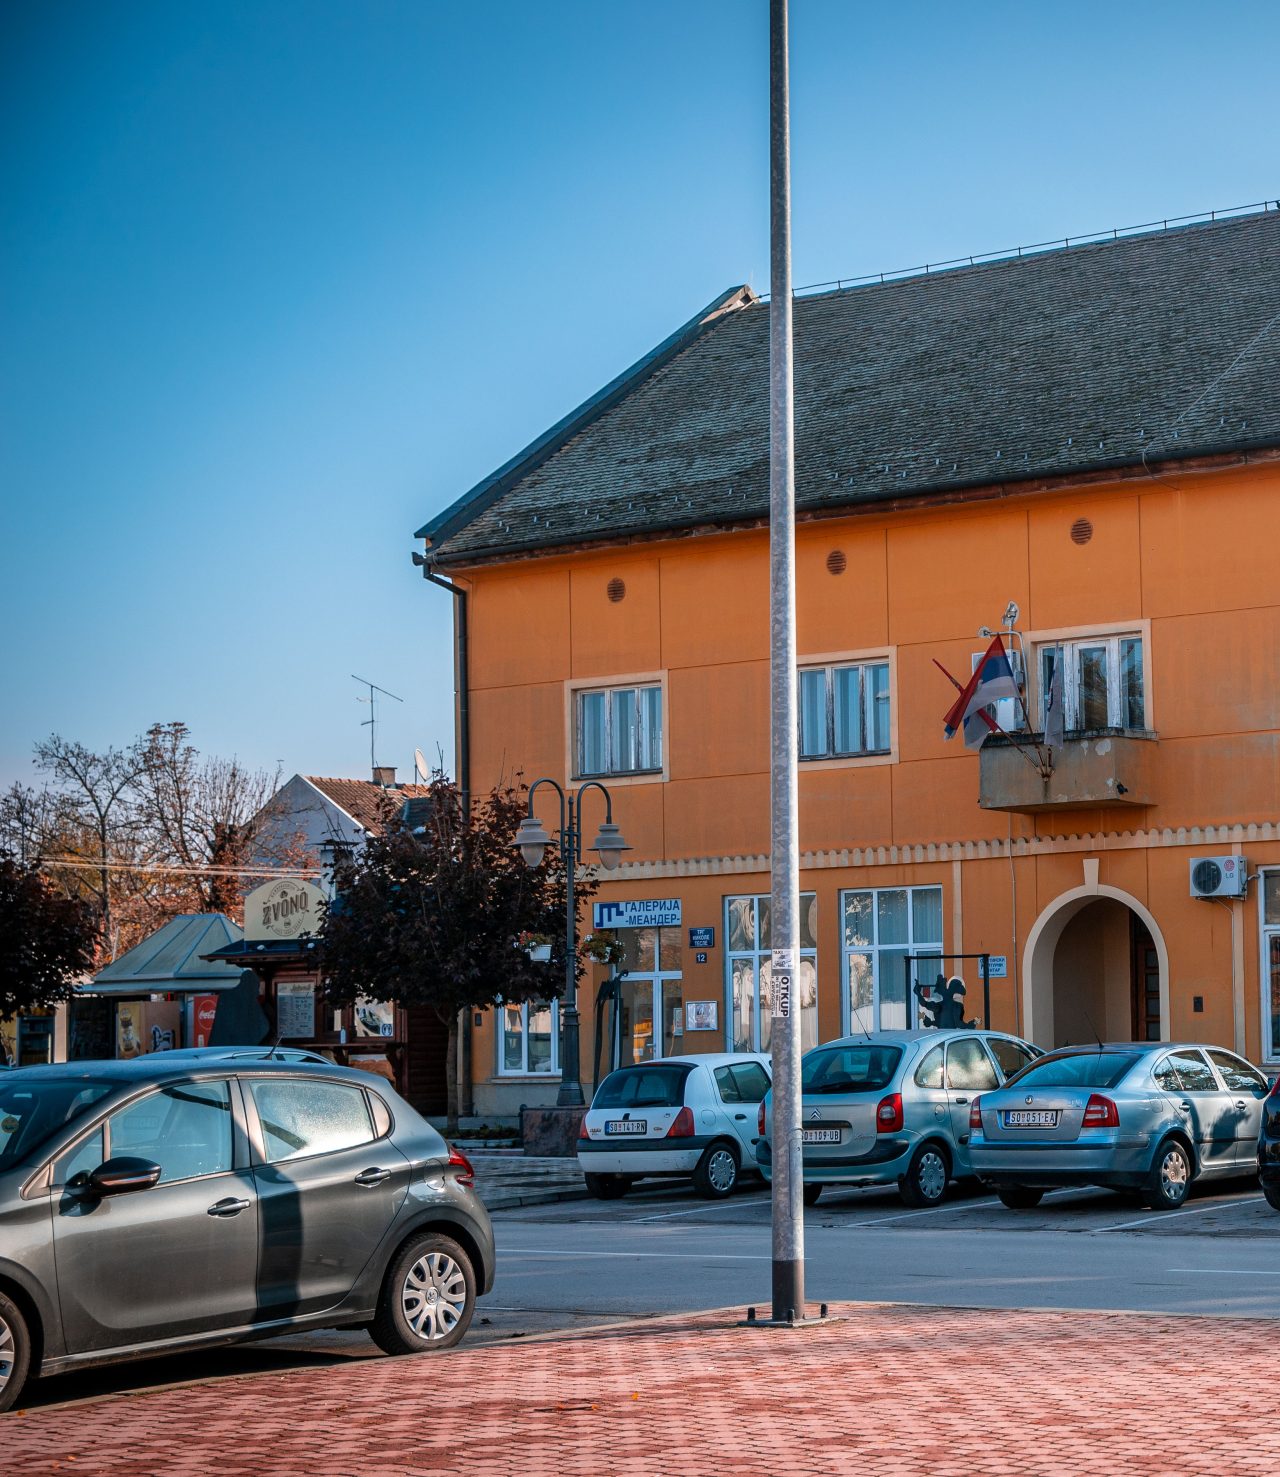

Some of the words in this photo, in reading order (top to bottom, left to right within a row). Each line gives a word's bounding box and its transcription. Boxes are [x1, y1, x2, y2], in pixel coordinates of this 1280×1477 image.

[262, 891, 309, 926] ZVONO
[625, 900, 680, 912] ГАЛЕРИЈА
[697, 954, 705, 962] 12
[781, 976, 789, 1017] OTKUP
